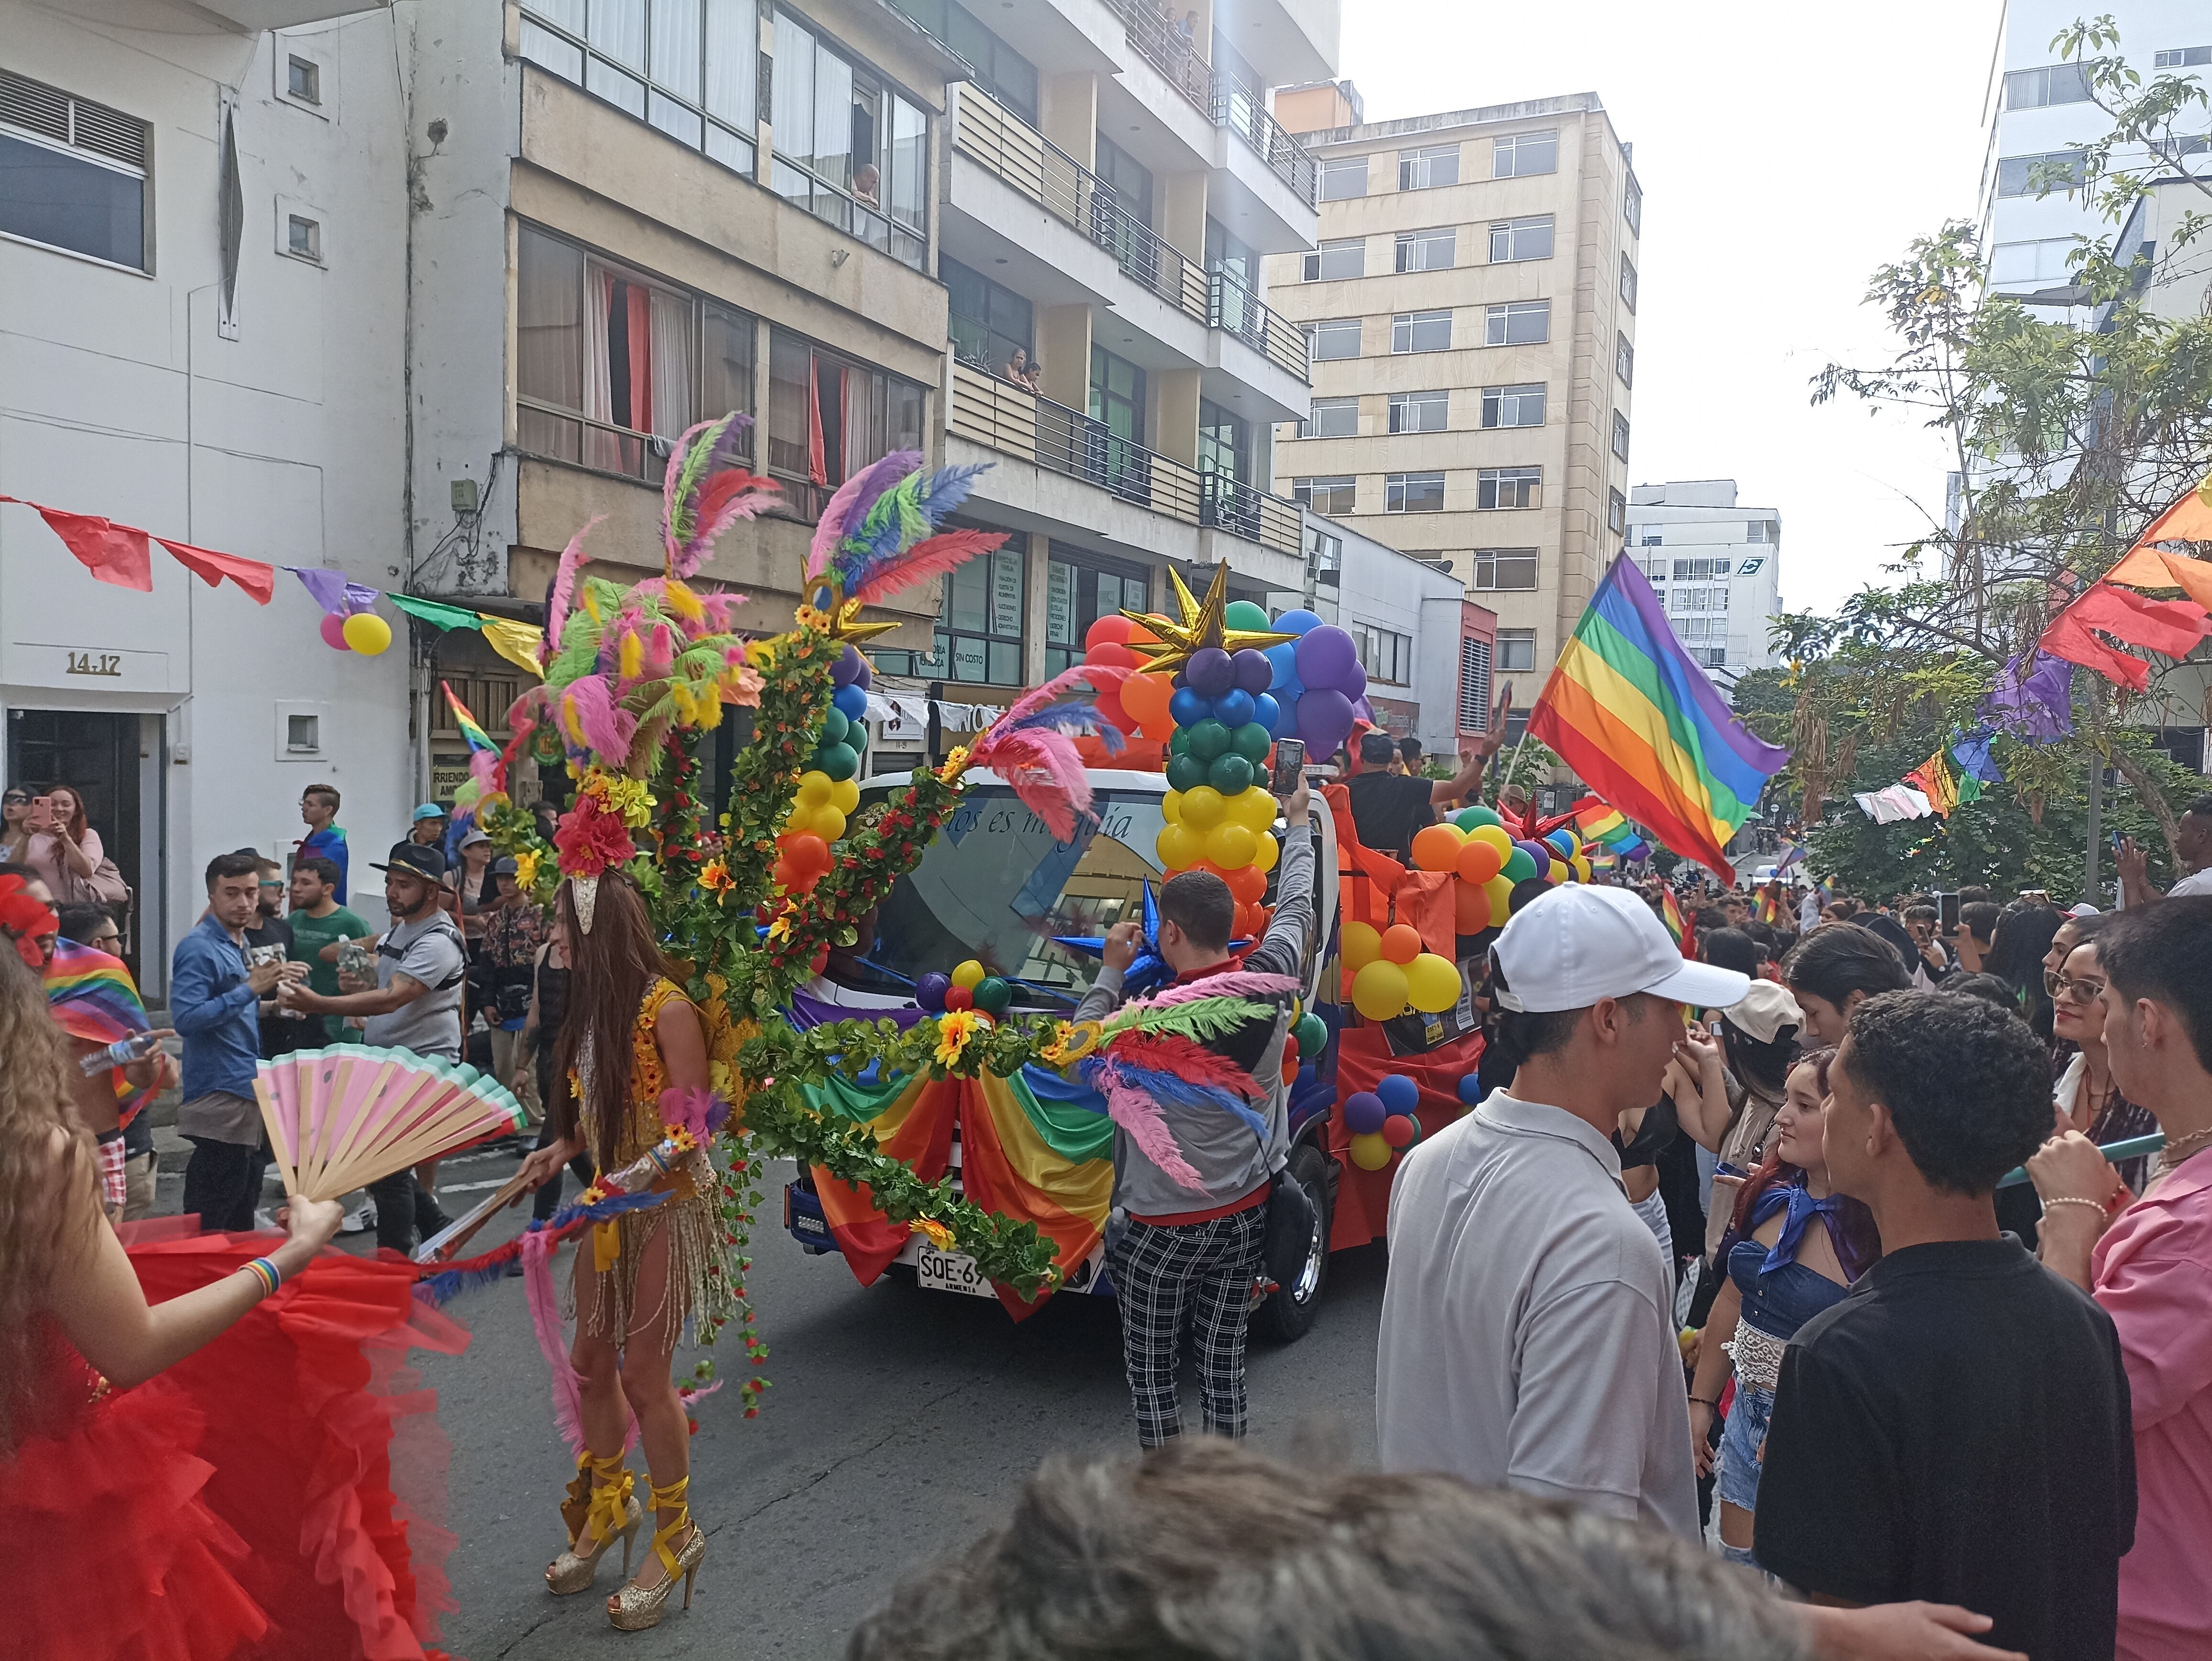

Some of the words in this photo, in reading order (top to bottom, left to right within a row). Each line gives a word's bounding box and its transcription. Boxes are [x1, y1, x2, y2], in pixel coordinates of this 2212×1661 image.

[956, 653, 964, 662] SIN
[965, 653, 984, 664] COSTO
[946, 810, 983, 833] ios
[988, 810, 1015, 833] es
[945, 1283, 976, 1293] ARMENIA
